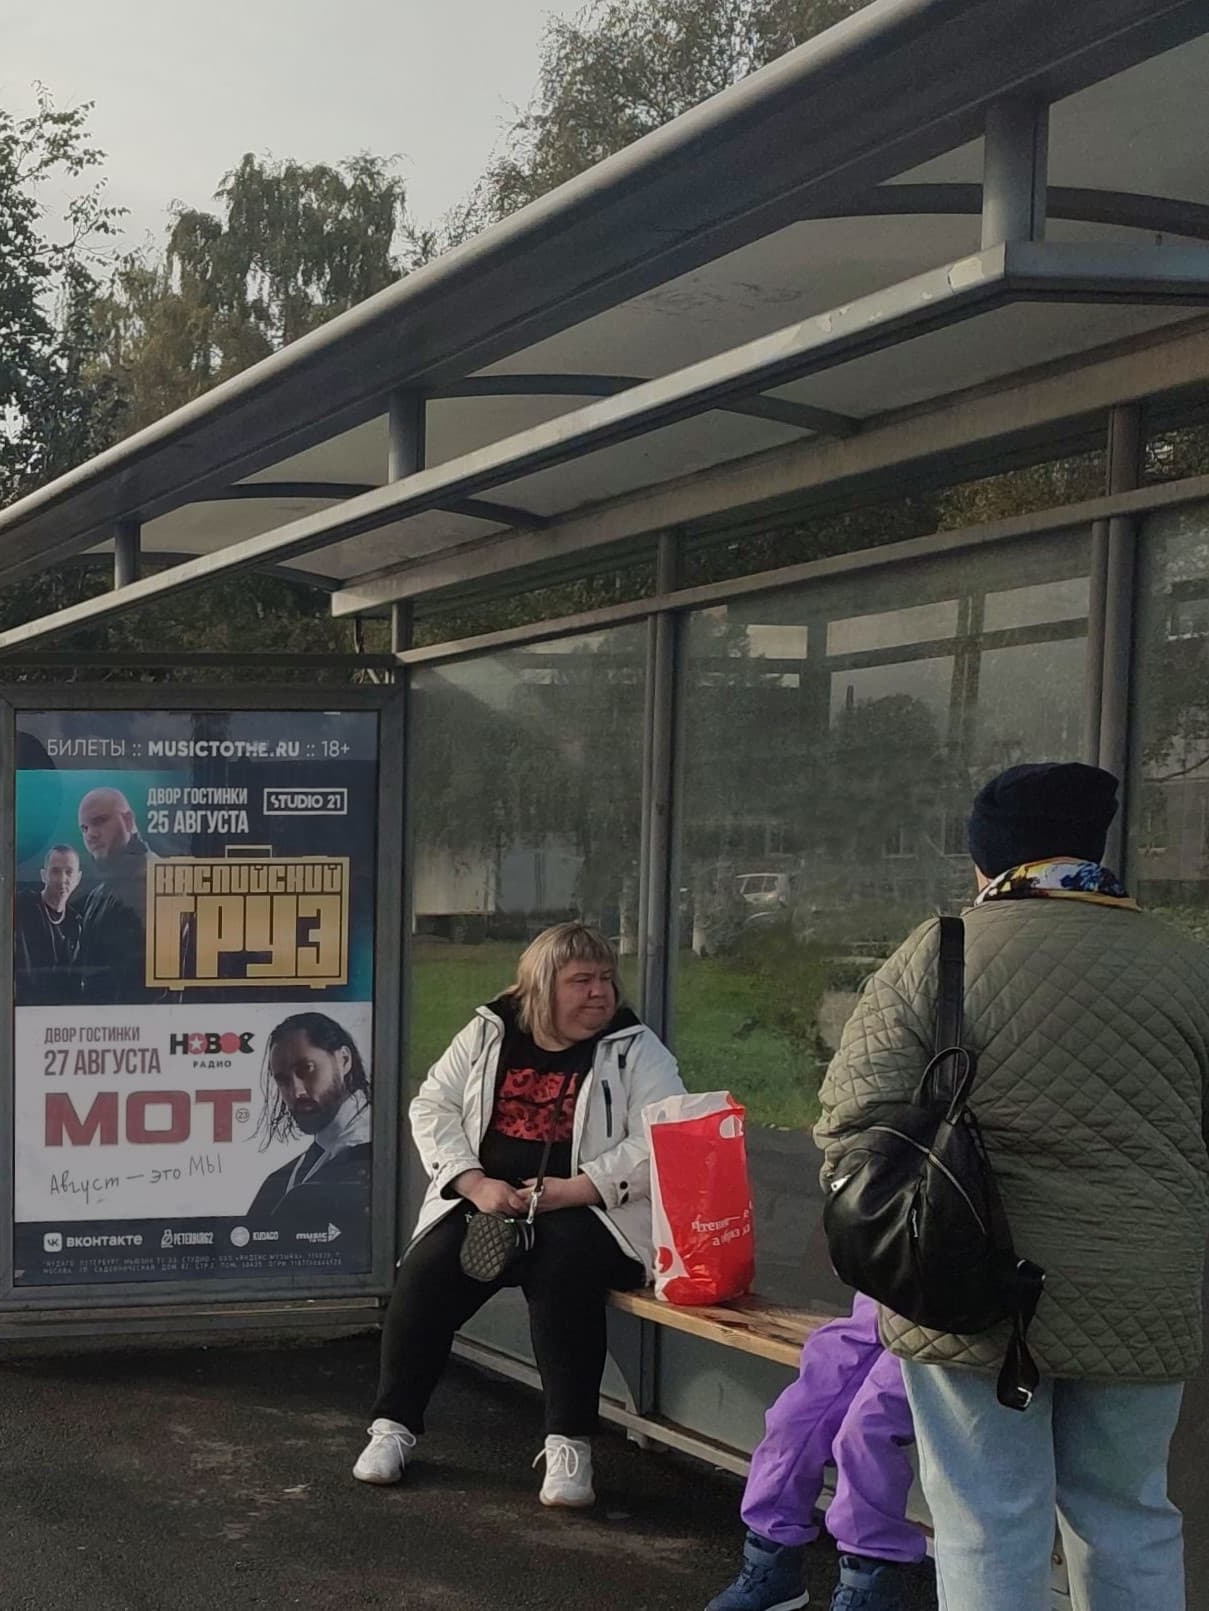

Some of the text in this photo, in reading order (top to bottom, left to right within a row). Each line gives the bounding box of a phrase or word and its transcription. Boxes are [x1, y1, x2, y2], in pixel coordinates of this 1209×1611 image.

[47, 739, 125, 756] БИЛЕТЫ
[148, 740, 299, 757] MUSICTOTHE.RU
[321, 740, 350, 757] 18+
[147, 788, 248, 806] ДВОР ГОСТИНКИ
[270, 794, 341, 809] STUDIO 21
[147, 810, 249, 833] 25 АВГУСТА
[155, 864, 342, 894] КАСПИЙСКИЙ
[155, 895, 341, 978] ГРУЗ
[44, 1026, 141, 1044] ДВОР ГОСТИНКИ
[44, 1048, 161, 1076] 27 АВГУСТА
[193, 1060, 232, 1068] РАДИО
[45, 1089, 251, 1147] МОТ
[50, 1170, 119, 1204] Август
[149, 1168, 181, 1183] это
